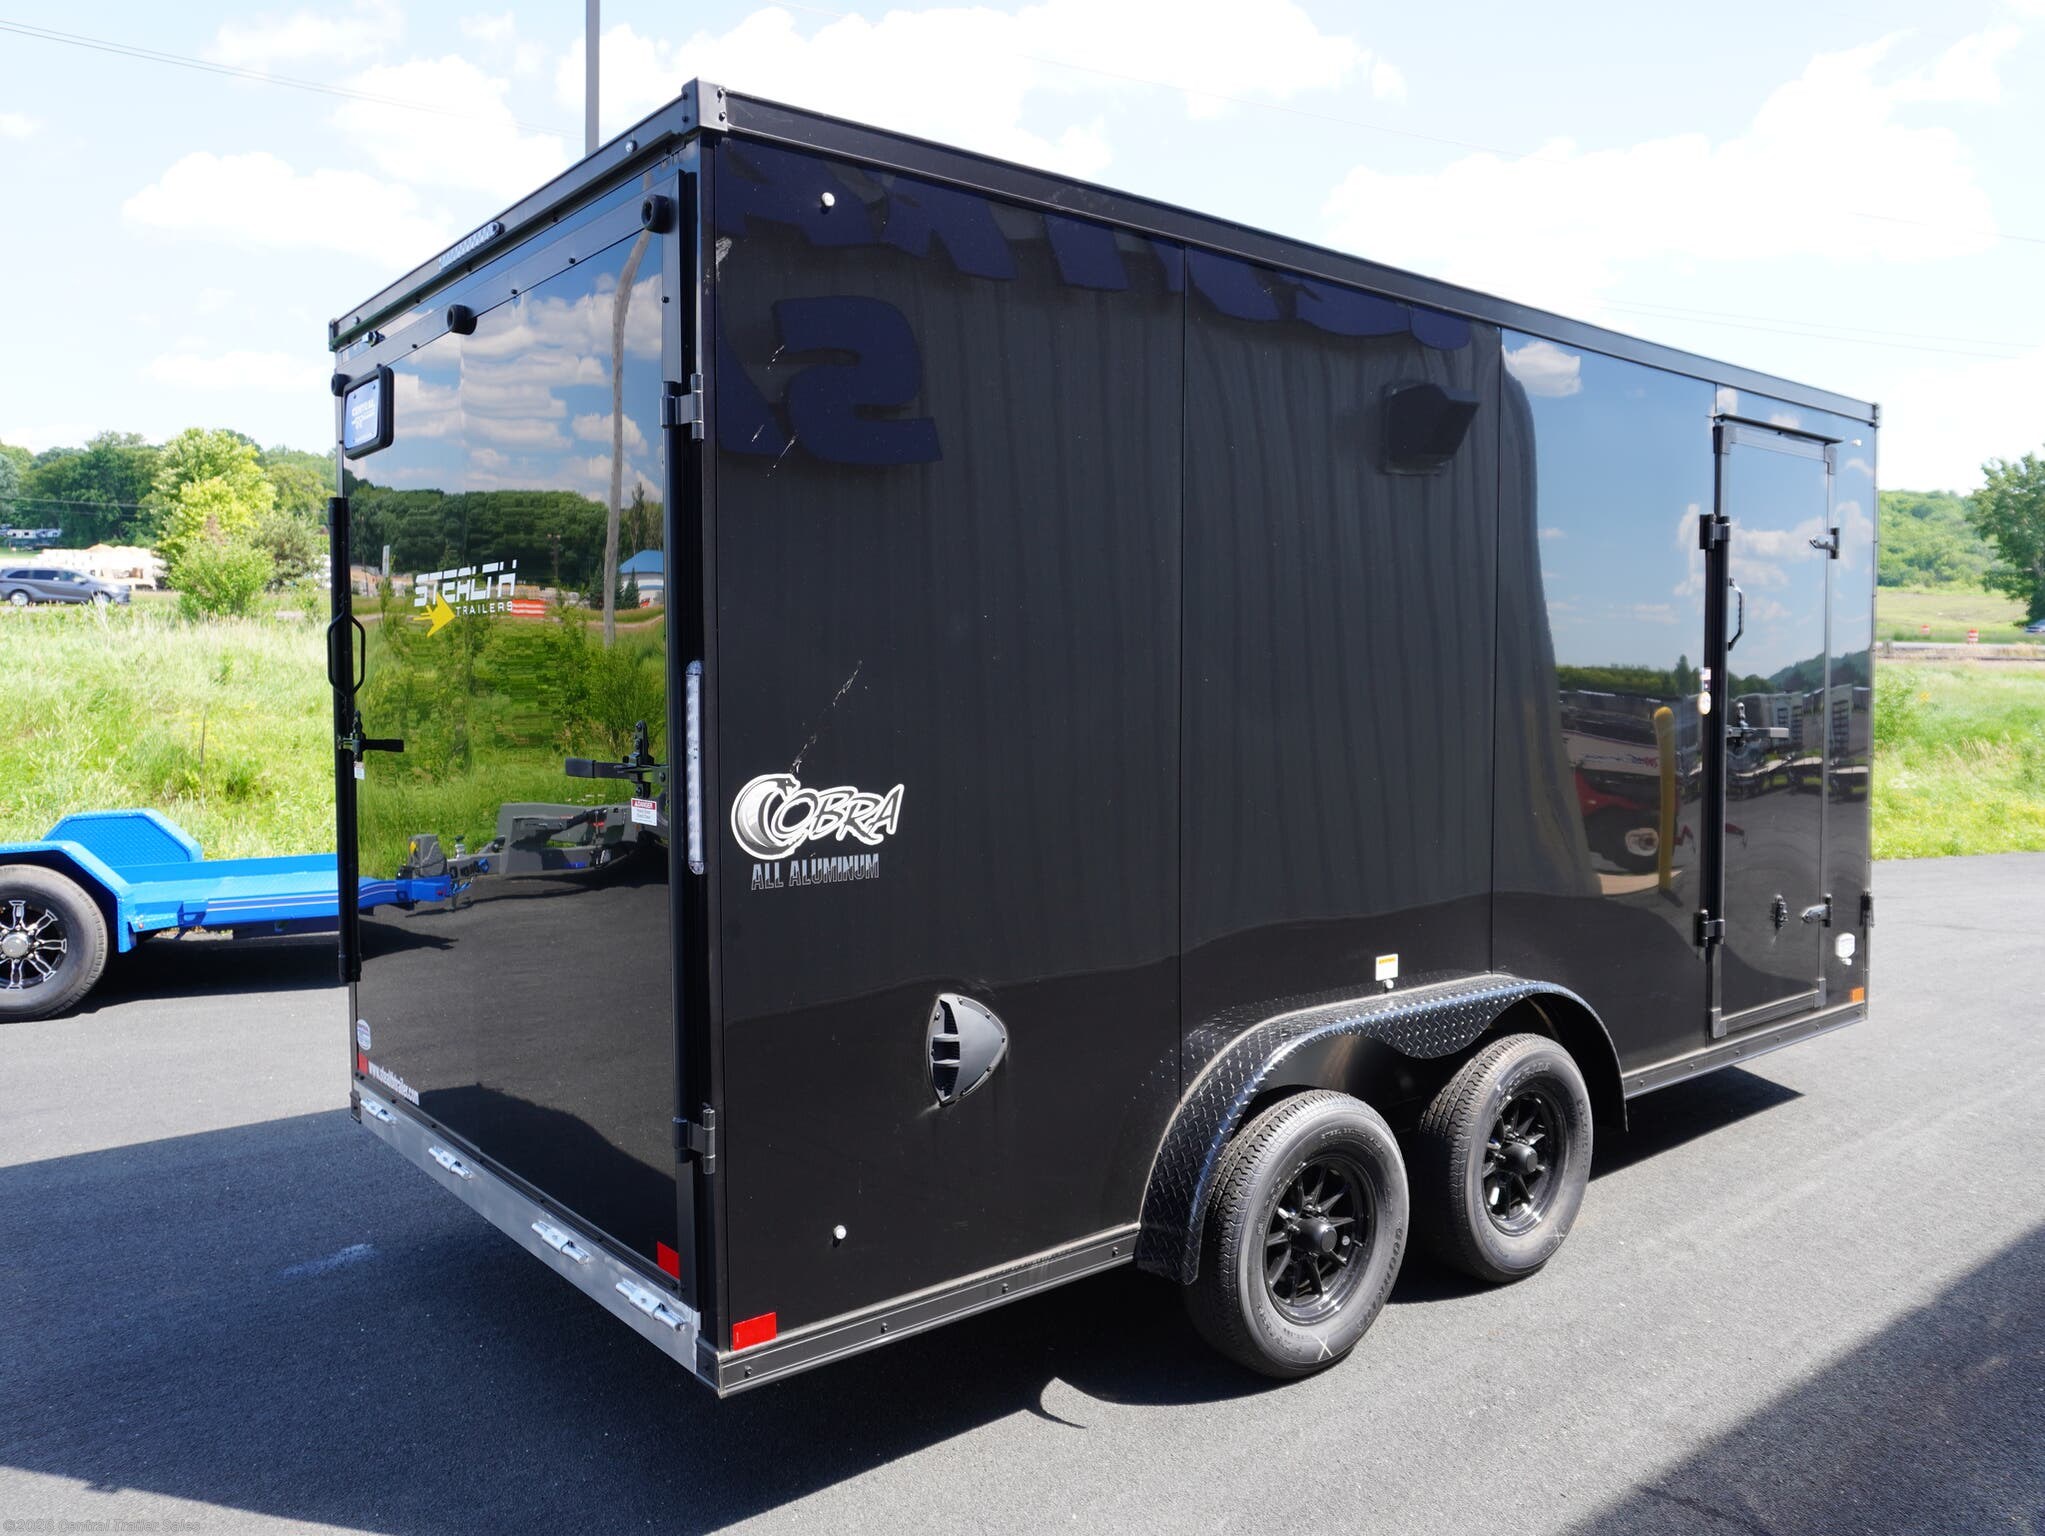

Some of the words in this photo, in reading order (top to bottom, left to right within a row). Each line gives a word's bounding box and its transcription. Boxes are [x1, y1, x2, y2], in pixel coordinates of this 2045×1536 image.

[413, 559, 518, 607] STEALTH
[455, 600, 514, 617] TRAILERS
[730, 773, 905, 861] COBRA
[751, 862, 784, 891] ALL
[788, 853, 881, 887] ALUMINUM
